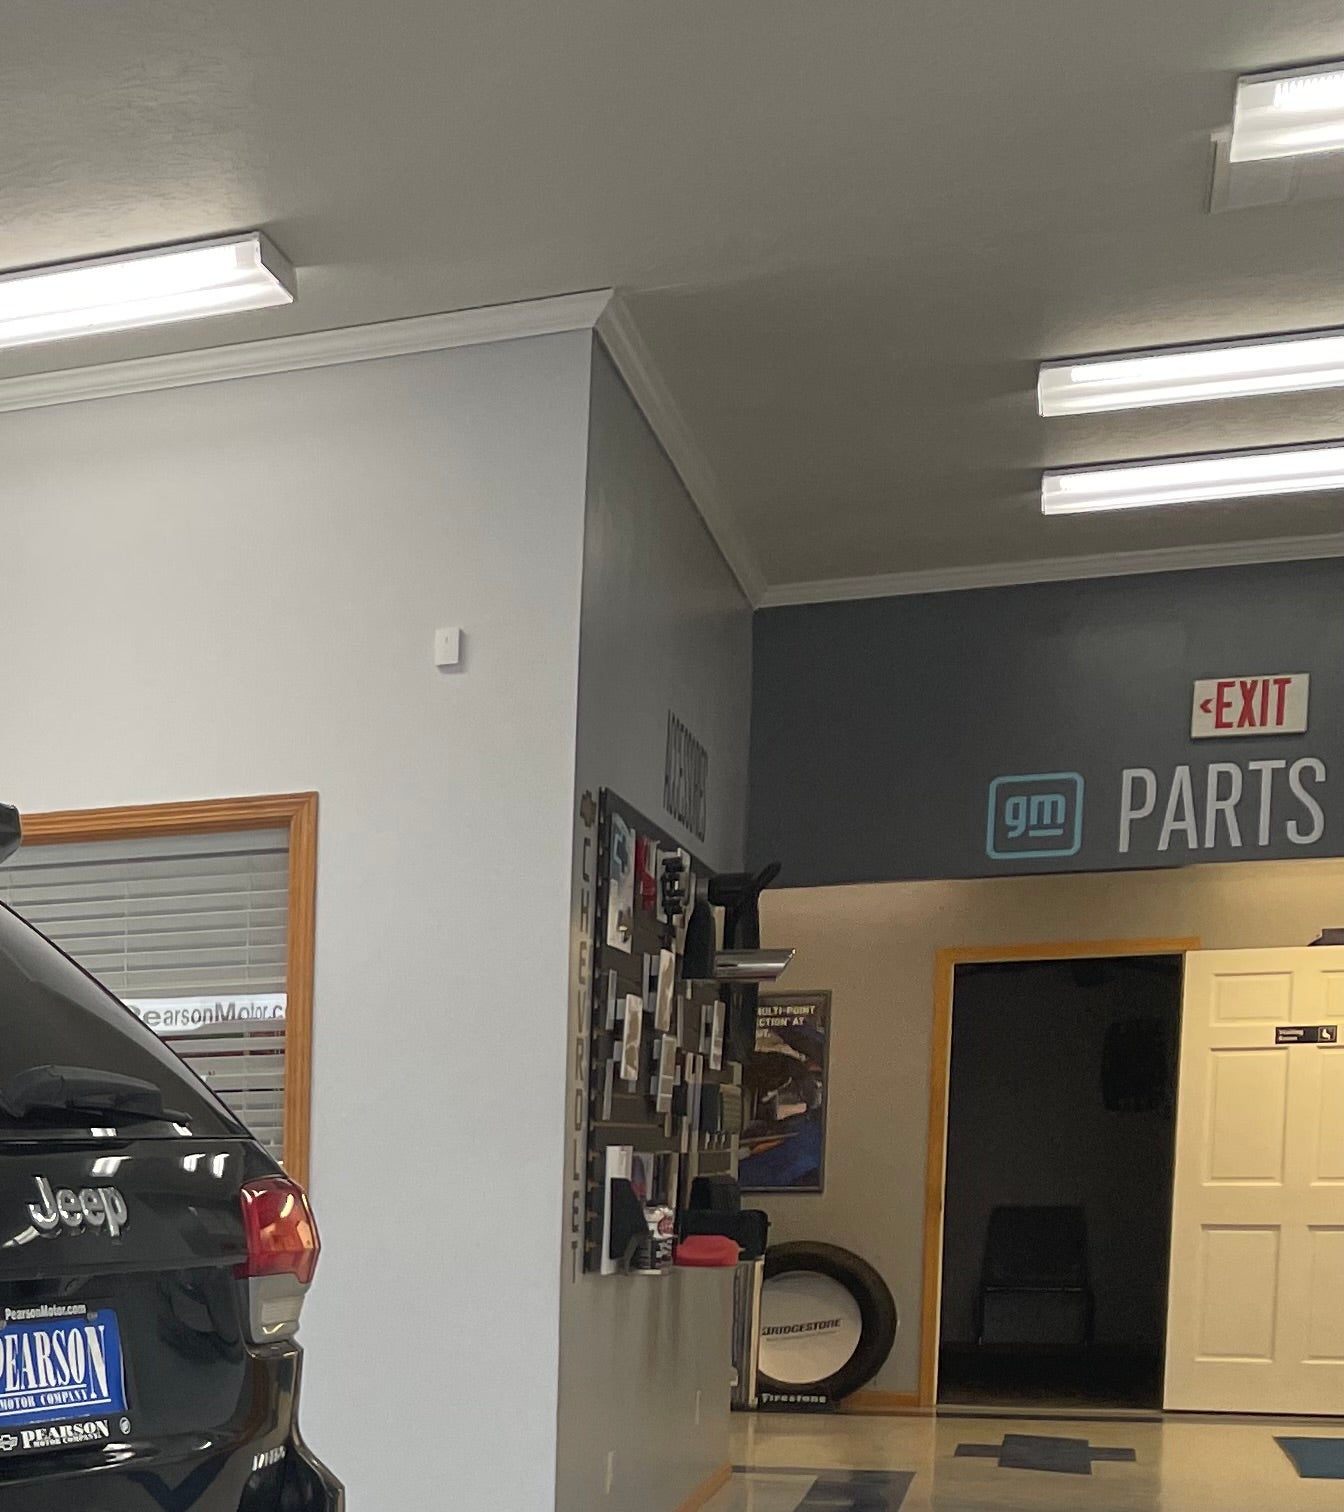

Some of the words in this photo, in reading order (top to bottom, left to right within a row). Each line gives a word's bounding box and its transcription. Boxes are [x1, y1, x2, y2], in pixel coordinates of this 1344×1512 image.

[1214, 677, 1292, 729] EXIT
[1004, 793, 1066, 839] gm
[1119, 757, 1327, 852] PARTS
[27, 1176, 128, 1237] Jeep
[4, 1304, 87, 1320] PearsonMotor.com
[761, 1319, 841, 1336] BRIDGESTONE
[0, 1395, 35, 1411] MOTOR
[40, 1388, 88, 1405] COMPANY
[761, 1392, 827, 1403] Firestone
[20, 1419, 110, 1449] PEARSON
